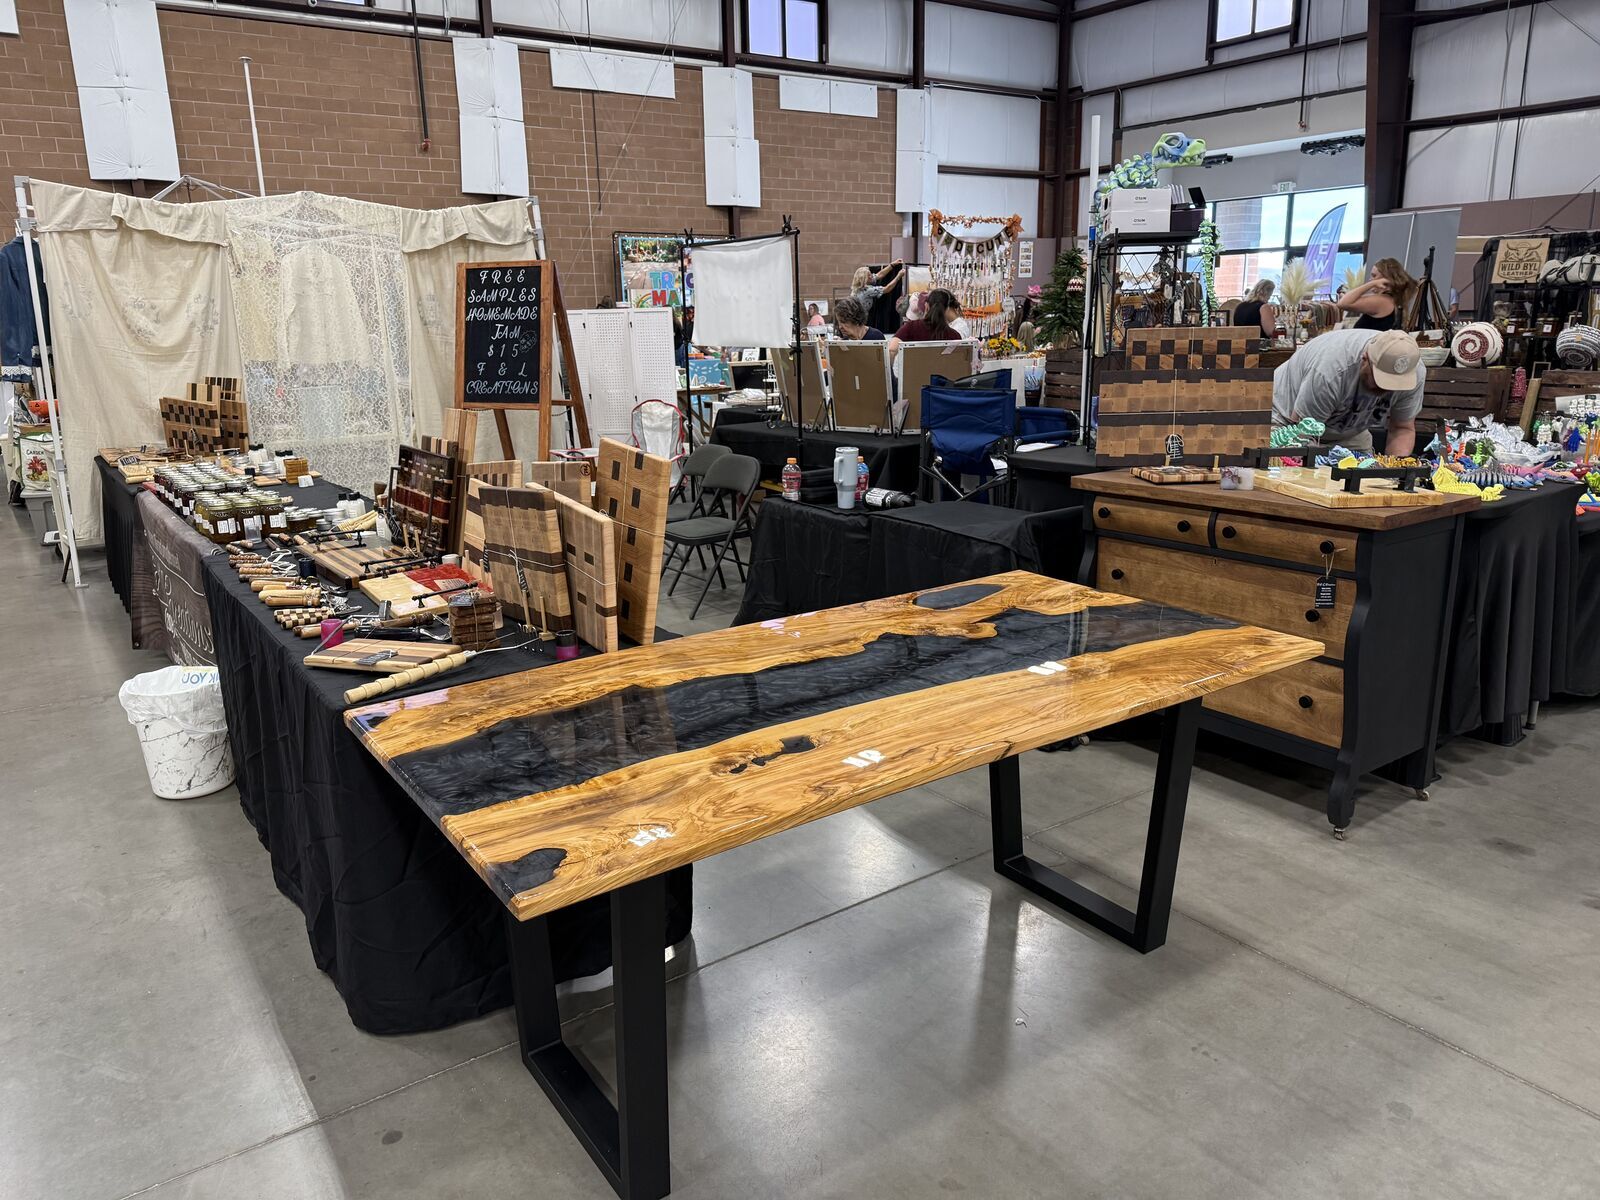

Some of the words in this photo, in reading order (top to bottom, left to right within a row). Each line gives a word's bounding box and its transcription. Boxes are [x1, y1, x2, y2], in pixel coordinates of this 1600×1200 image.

[1501, 262, 1520, 272] WILD
[480, 269, 526, 285] FREE
[467, 287, 537, 304] SAMPLES
[465, 306, 538, 322] HOMEMADE
[490, 323, 521, 341] JAM
[487, 343, 519, 358] $15
[477, 362, 486, 376] F
[498, 362, 507, 376] &
[518, 362, 528, 377] L
[466, 380, 539, 395] CREATIONS
